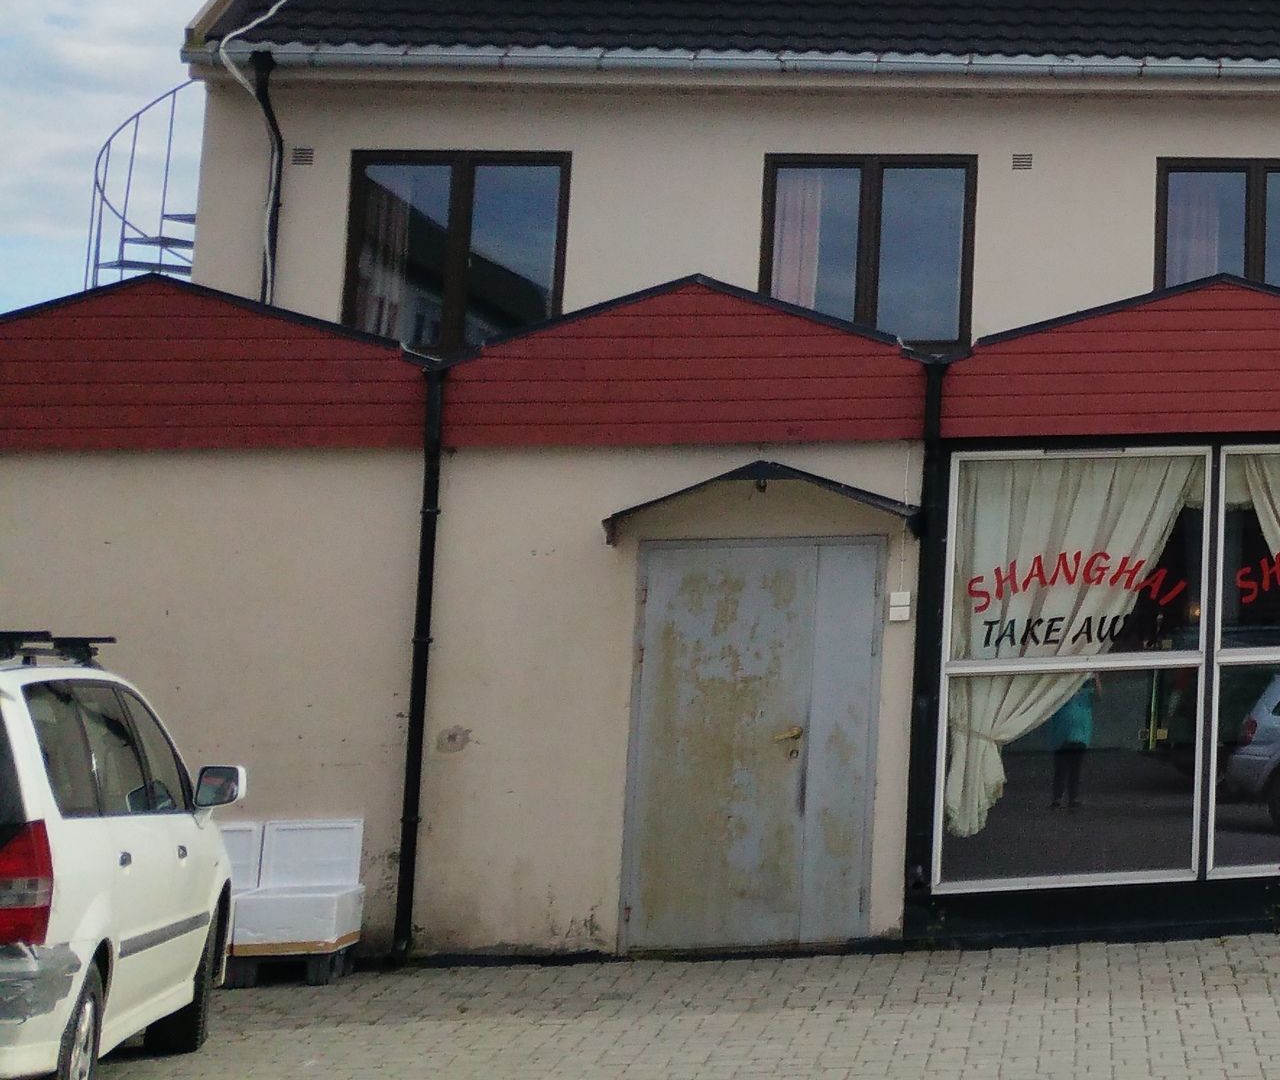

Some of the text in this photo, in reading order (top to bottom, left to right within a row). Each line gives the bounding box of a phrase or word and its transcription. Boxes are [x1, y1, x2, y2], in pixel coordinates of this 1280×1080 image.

[967, 551, 1188, 613] SHANGHAI
[983, 613, 1136, 648] TAKE AW
